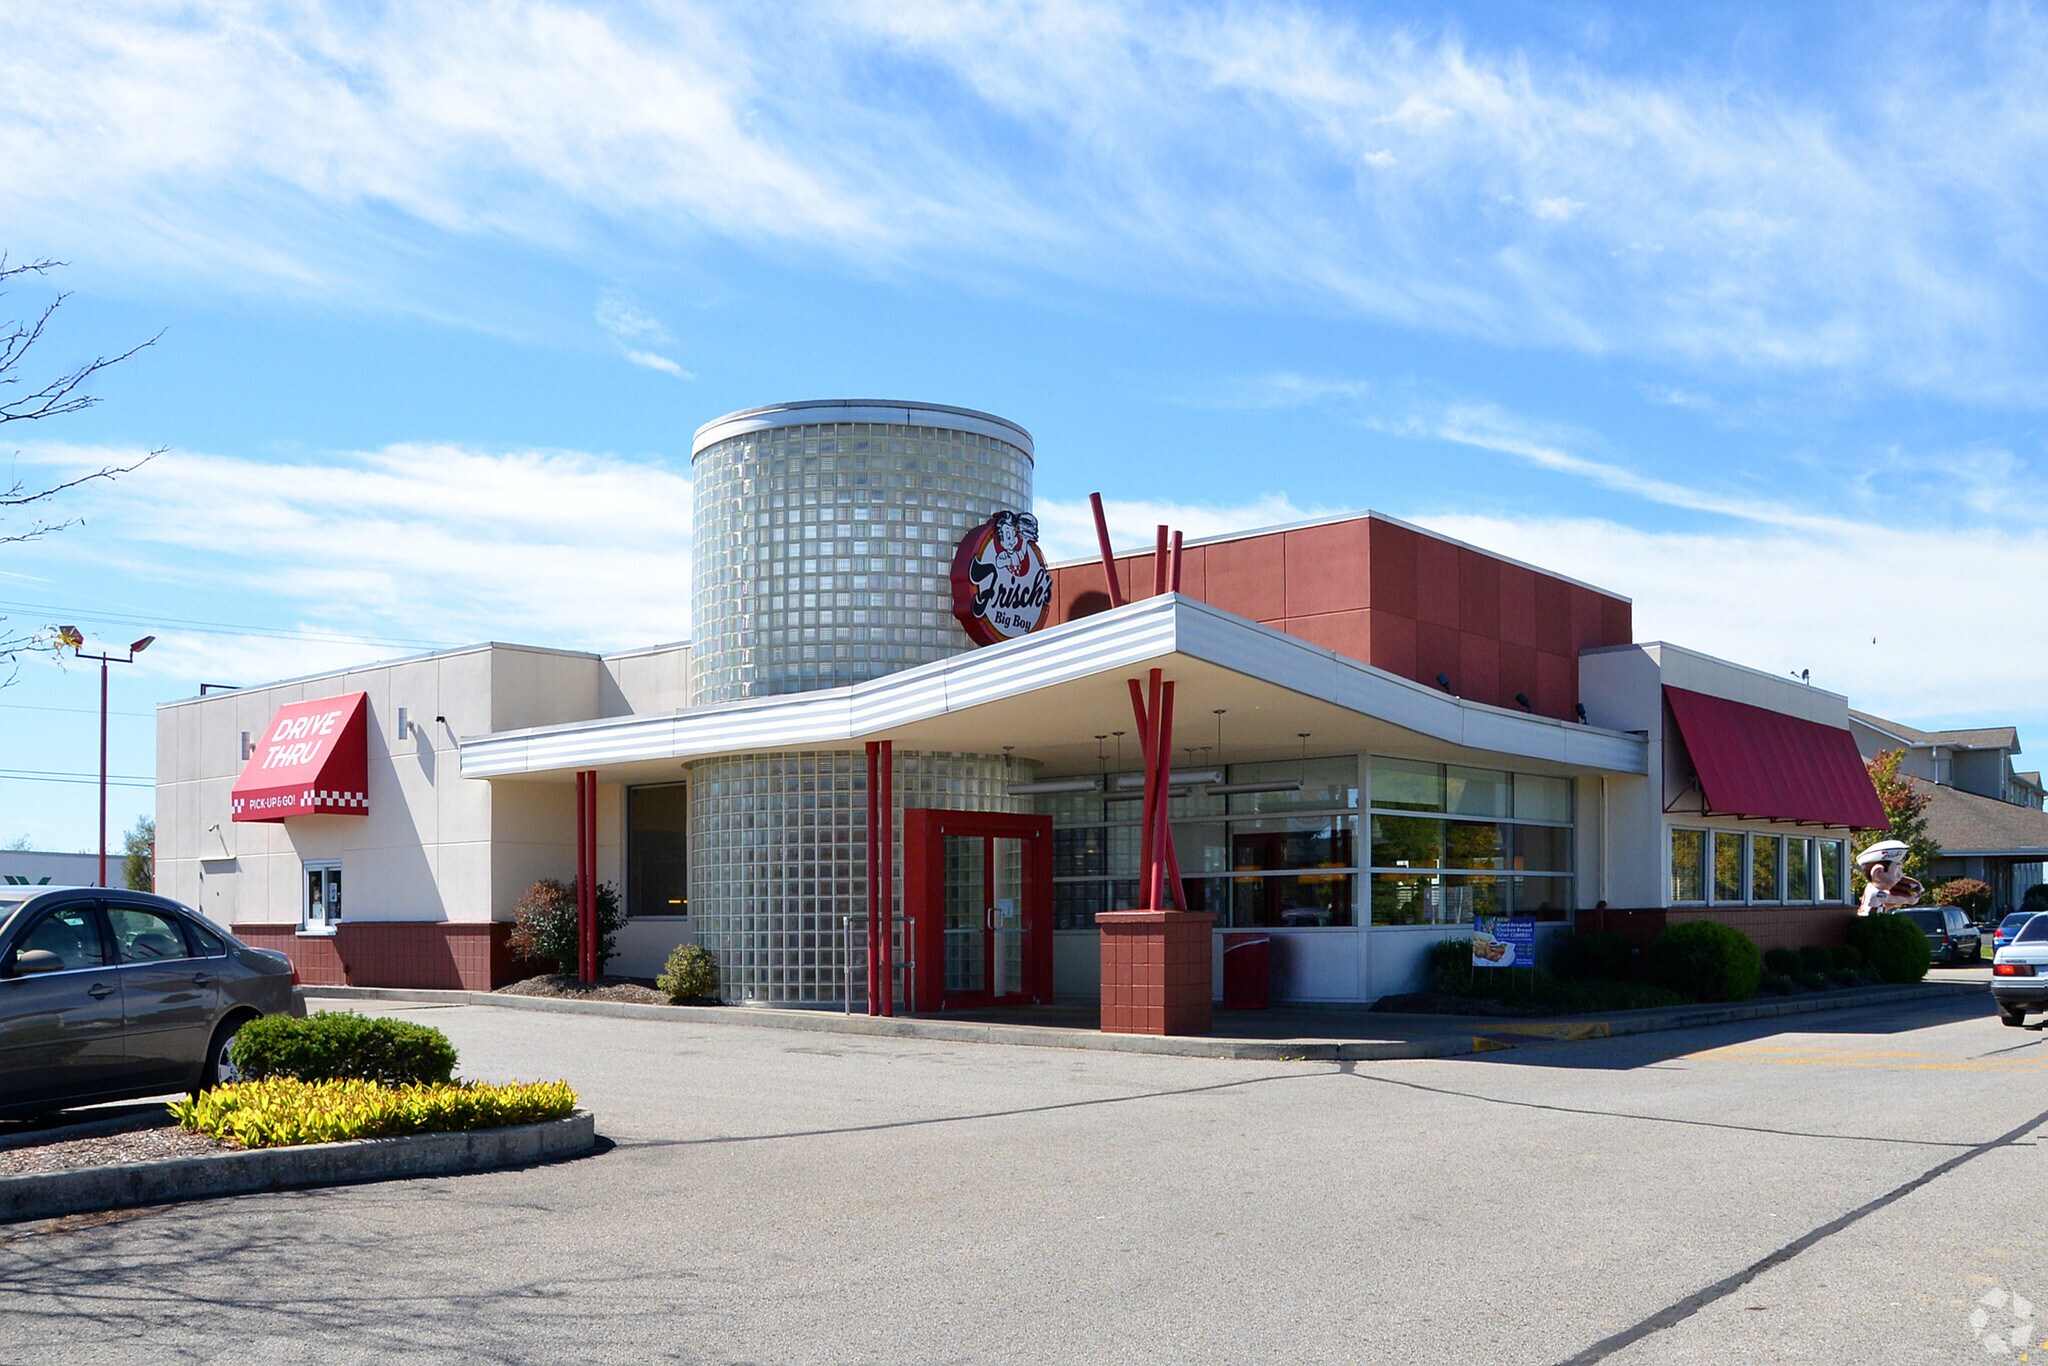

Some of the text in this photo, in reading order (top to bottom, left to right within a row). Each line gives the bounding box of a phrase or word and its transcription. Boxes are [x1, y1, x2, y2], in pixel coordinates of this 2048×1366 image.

[970, 558, 1053, 617] Frisch's
[994, 611, 1031, 632] Big Boy
[271, 711, 342, 742] DRIVE
[262, 739, 323, 769] THRU
